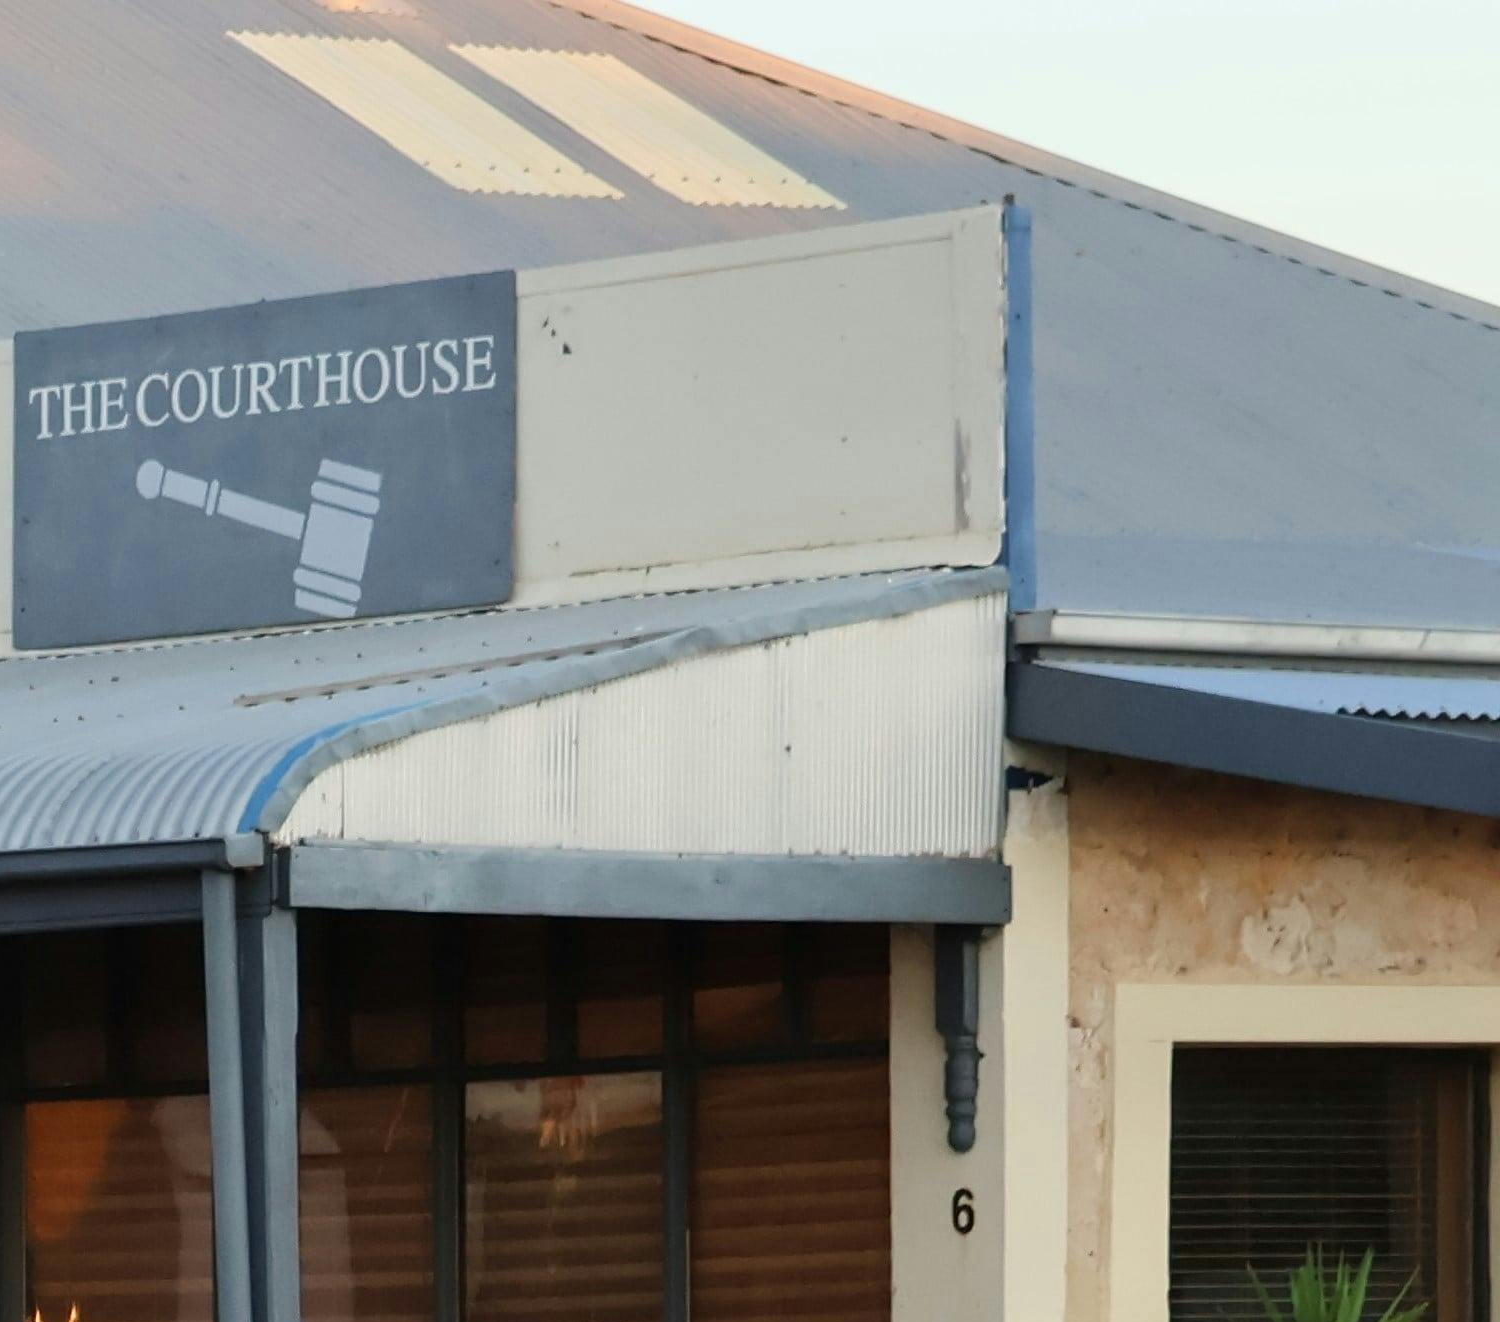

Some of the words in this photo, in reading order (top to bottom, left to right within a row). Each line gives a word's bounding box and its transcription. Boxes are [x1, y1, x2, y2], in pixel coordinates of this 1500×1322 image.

[28, 376, 129, 440] THE
[134, 335, 497, 428] COURTHOUSE
[952, 1187, 975, 1236] 6
